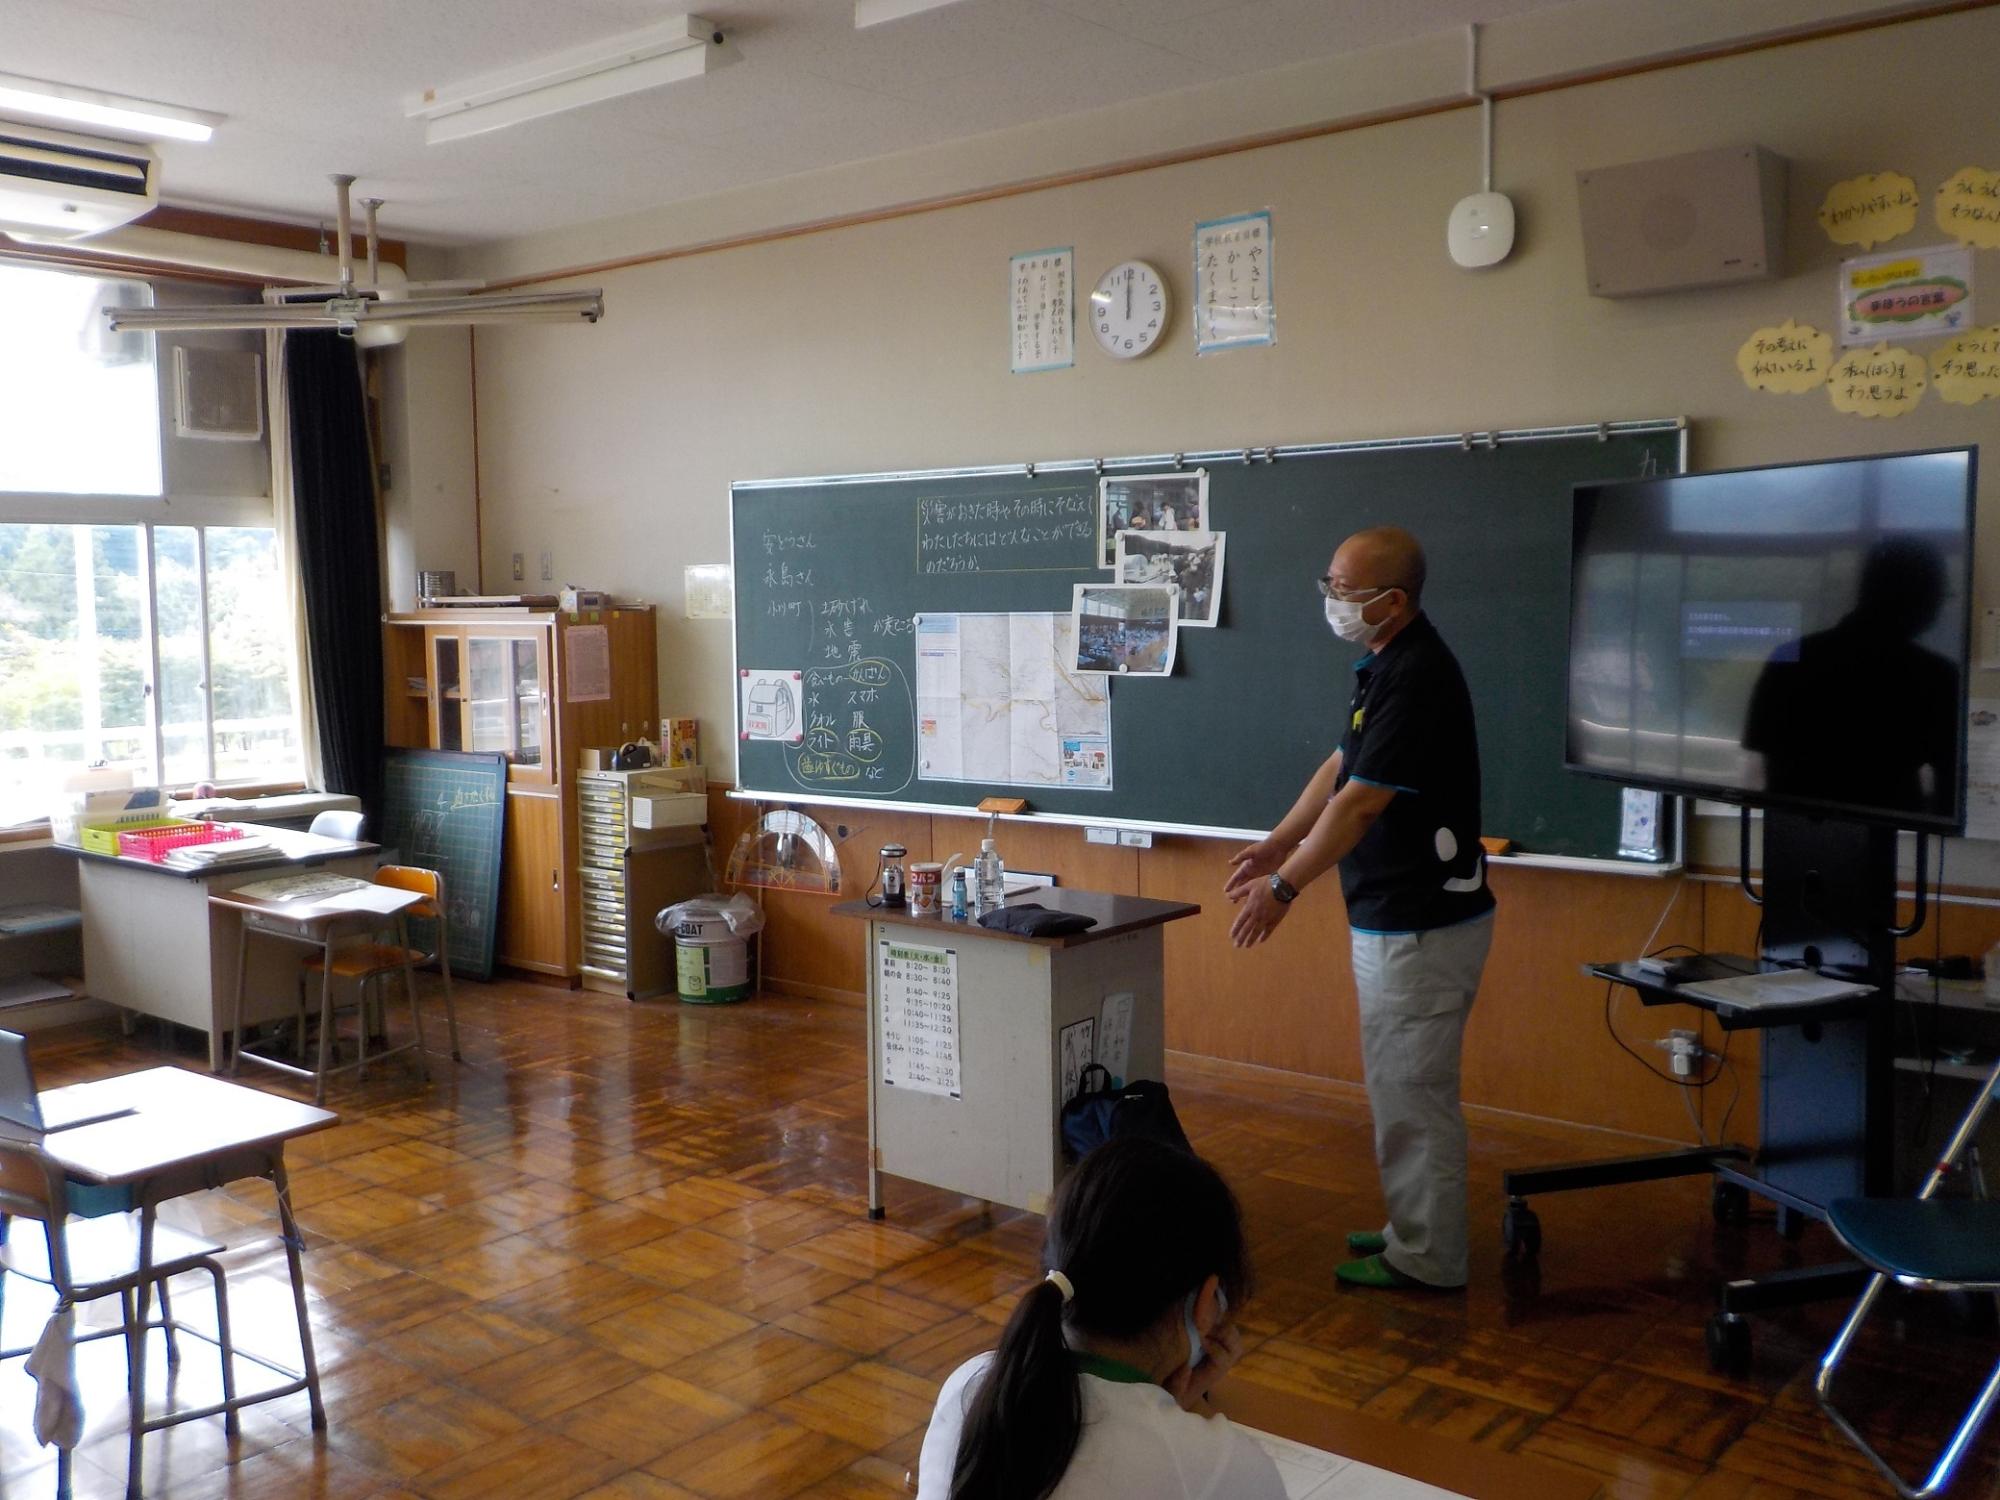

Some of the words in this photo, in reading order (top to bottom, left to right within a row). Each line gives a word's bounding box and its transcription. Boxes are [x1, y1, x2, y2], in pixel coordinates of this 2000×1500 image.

[1123, 269, 1134, 280] 12
[1141, 272, 1145, 282] 1
[1111, 275, 1120, 287] 11
[1249, 245, 1262, 320] やさしく
[1149, 284, 1157, 294] 2
[1207, 254, 1218, 340] たくましく
[1152, 301, 1161, 311] 3
[1098, 307, 1106, 317] 9
[1101, 323, 1109, 333] 8
[1148, 318, 1157, 328] 4
[1112, 336, 1120, 345] 7
[1139, 332, 1148, 342] 5
[1124, 339, 1133, 349] 6
[1845, 384, 1909, 401] そう思うよ
[808, 691, 820, 707] 水
[848, 687, 879, 704] スマホ
[853, 710, 870, 729] 服
[808, 732, 834, 749] ライト
[849, 731, 875, 752] 雨具
[865, 766, 885, 779] など
